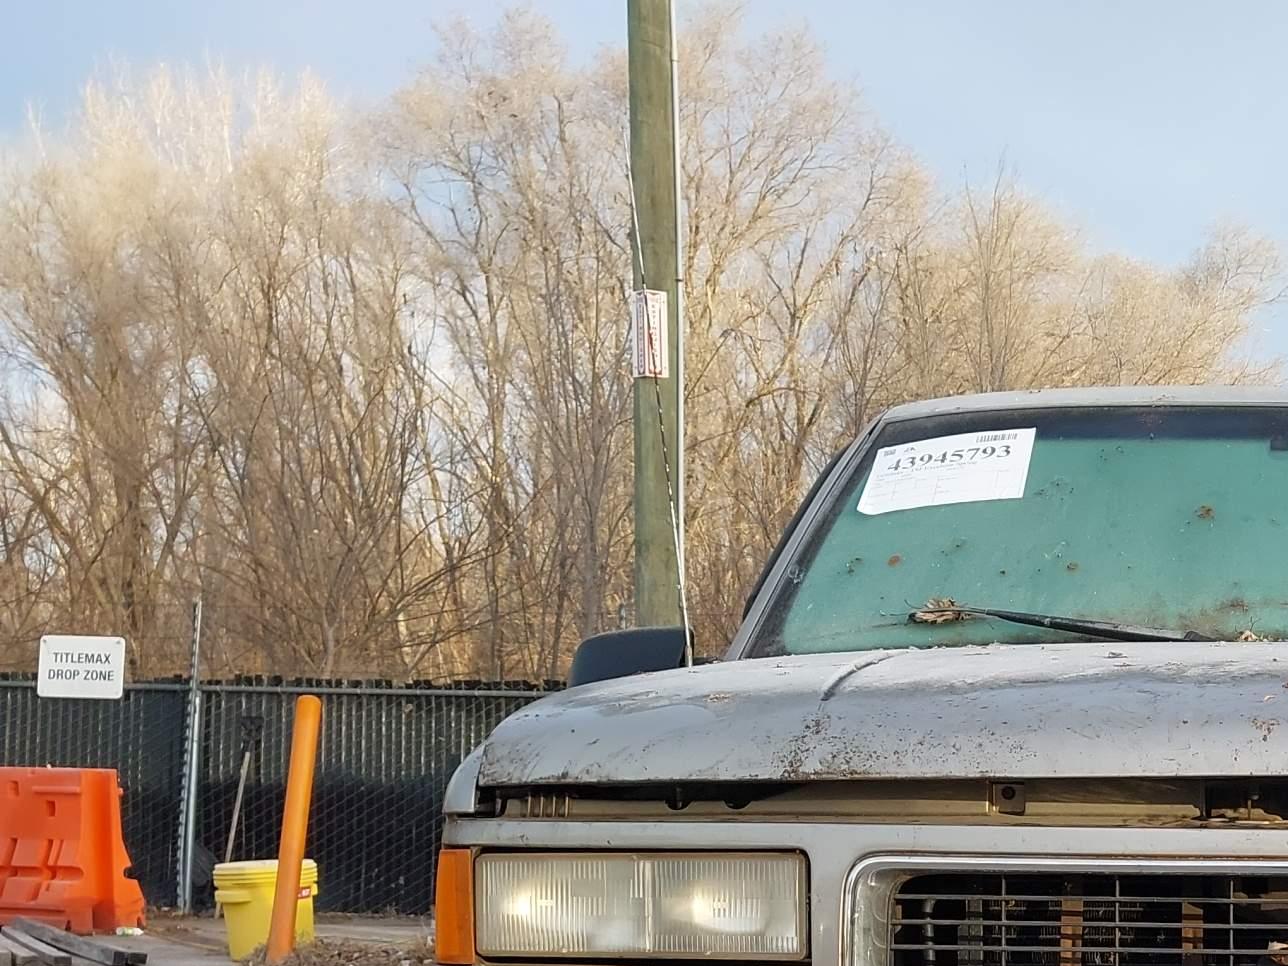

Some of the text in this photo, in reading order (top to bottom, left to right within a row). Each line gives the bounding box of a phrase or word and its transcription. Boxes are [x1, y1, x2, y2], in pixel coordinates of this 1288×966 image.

[888, 445, 1011, 471] 43945793
[53, 652, 111, 664] TITLEMAX
[48, 669, 114, 682] DROP ZONE
